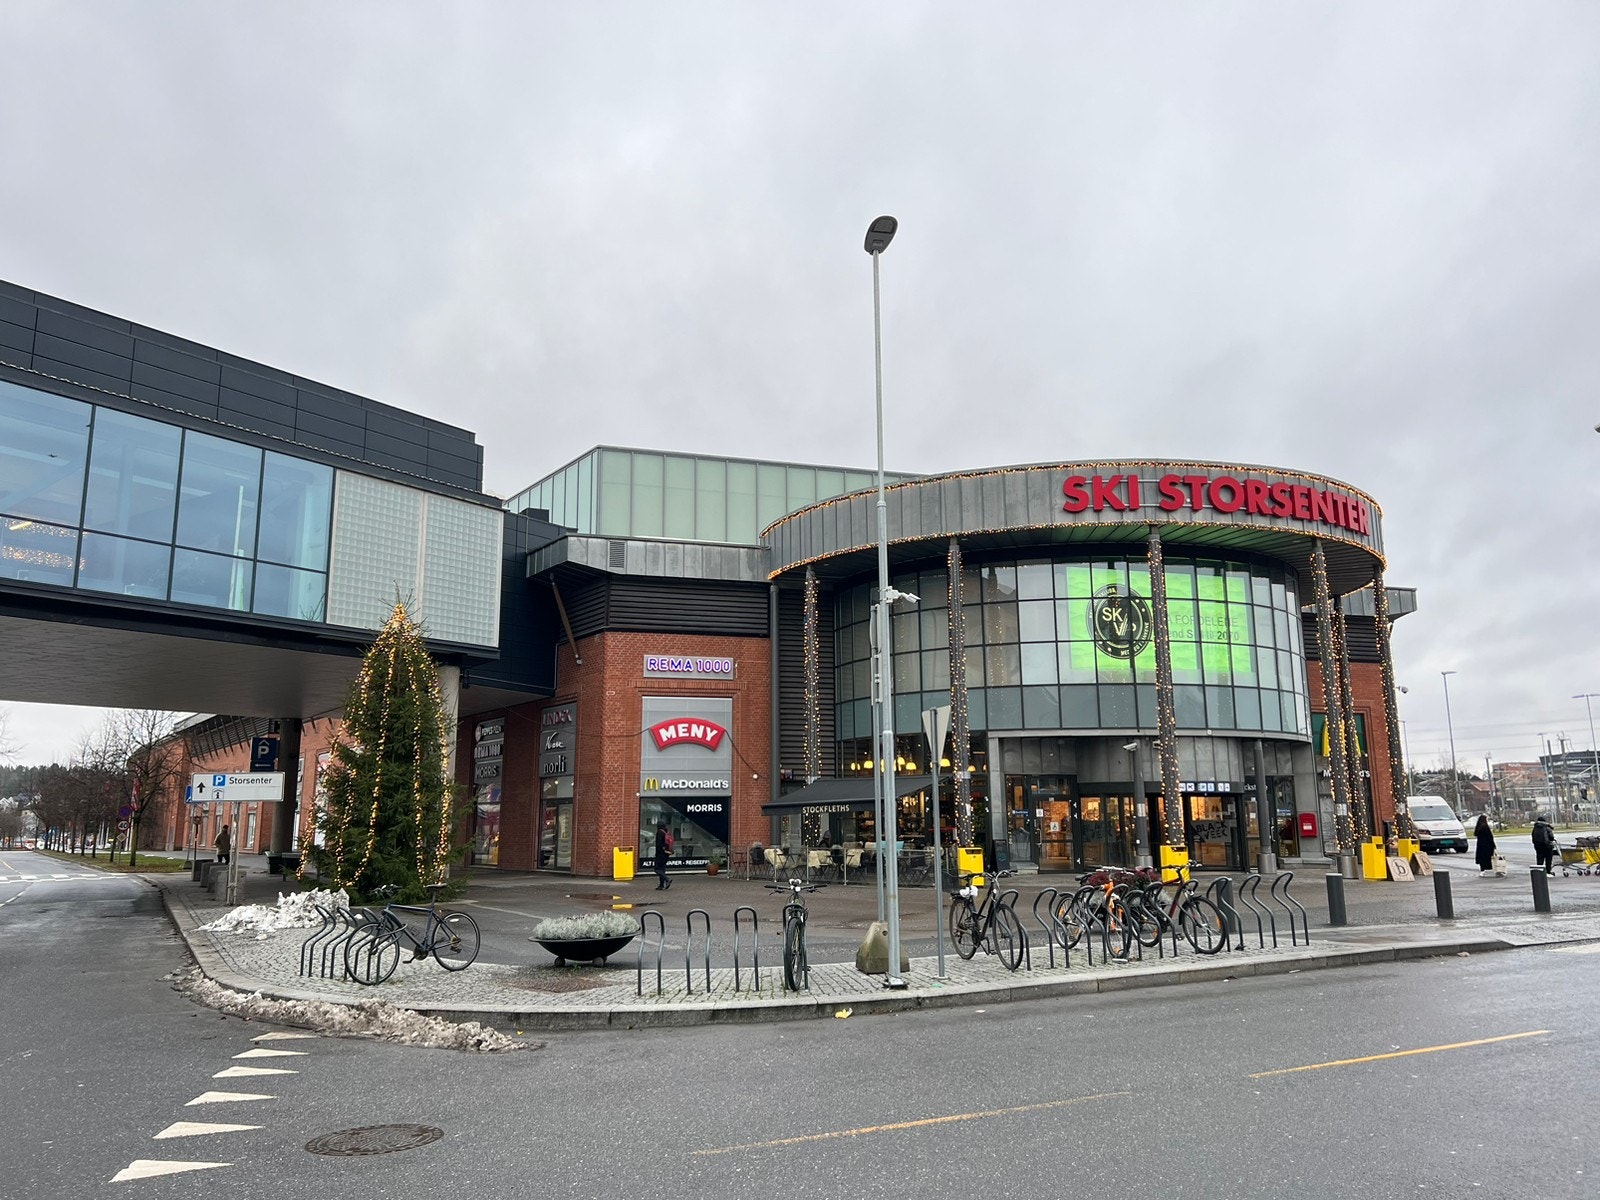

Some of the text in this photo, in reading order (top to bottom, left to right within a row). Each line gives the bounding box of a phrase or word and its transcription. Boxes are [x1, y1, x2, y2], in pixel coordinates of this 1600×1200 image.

[1062, 474, 1370, 536] SKI STORSENTER
[647, 657, 731, 673] REMA 1000
[659, 723, 718, 742] MENY
[543, 755, 565, 773] norli
[475, 765, 497, 778] MORRIS
[229, 776, 272, 785] Storsenter
[661, 779, 729, 789] McDonald's
[686, 803, 723, 813] MORRIS
[802, 804, 850, 814] STOCKFLETHS
[1196, 820, 1228, 832] BLACK
